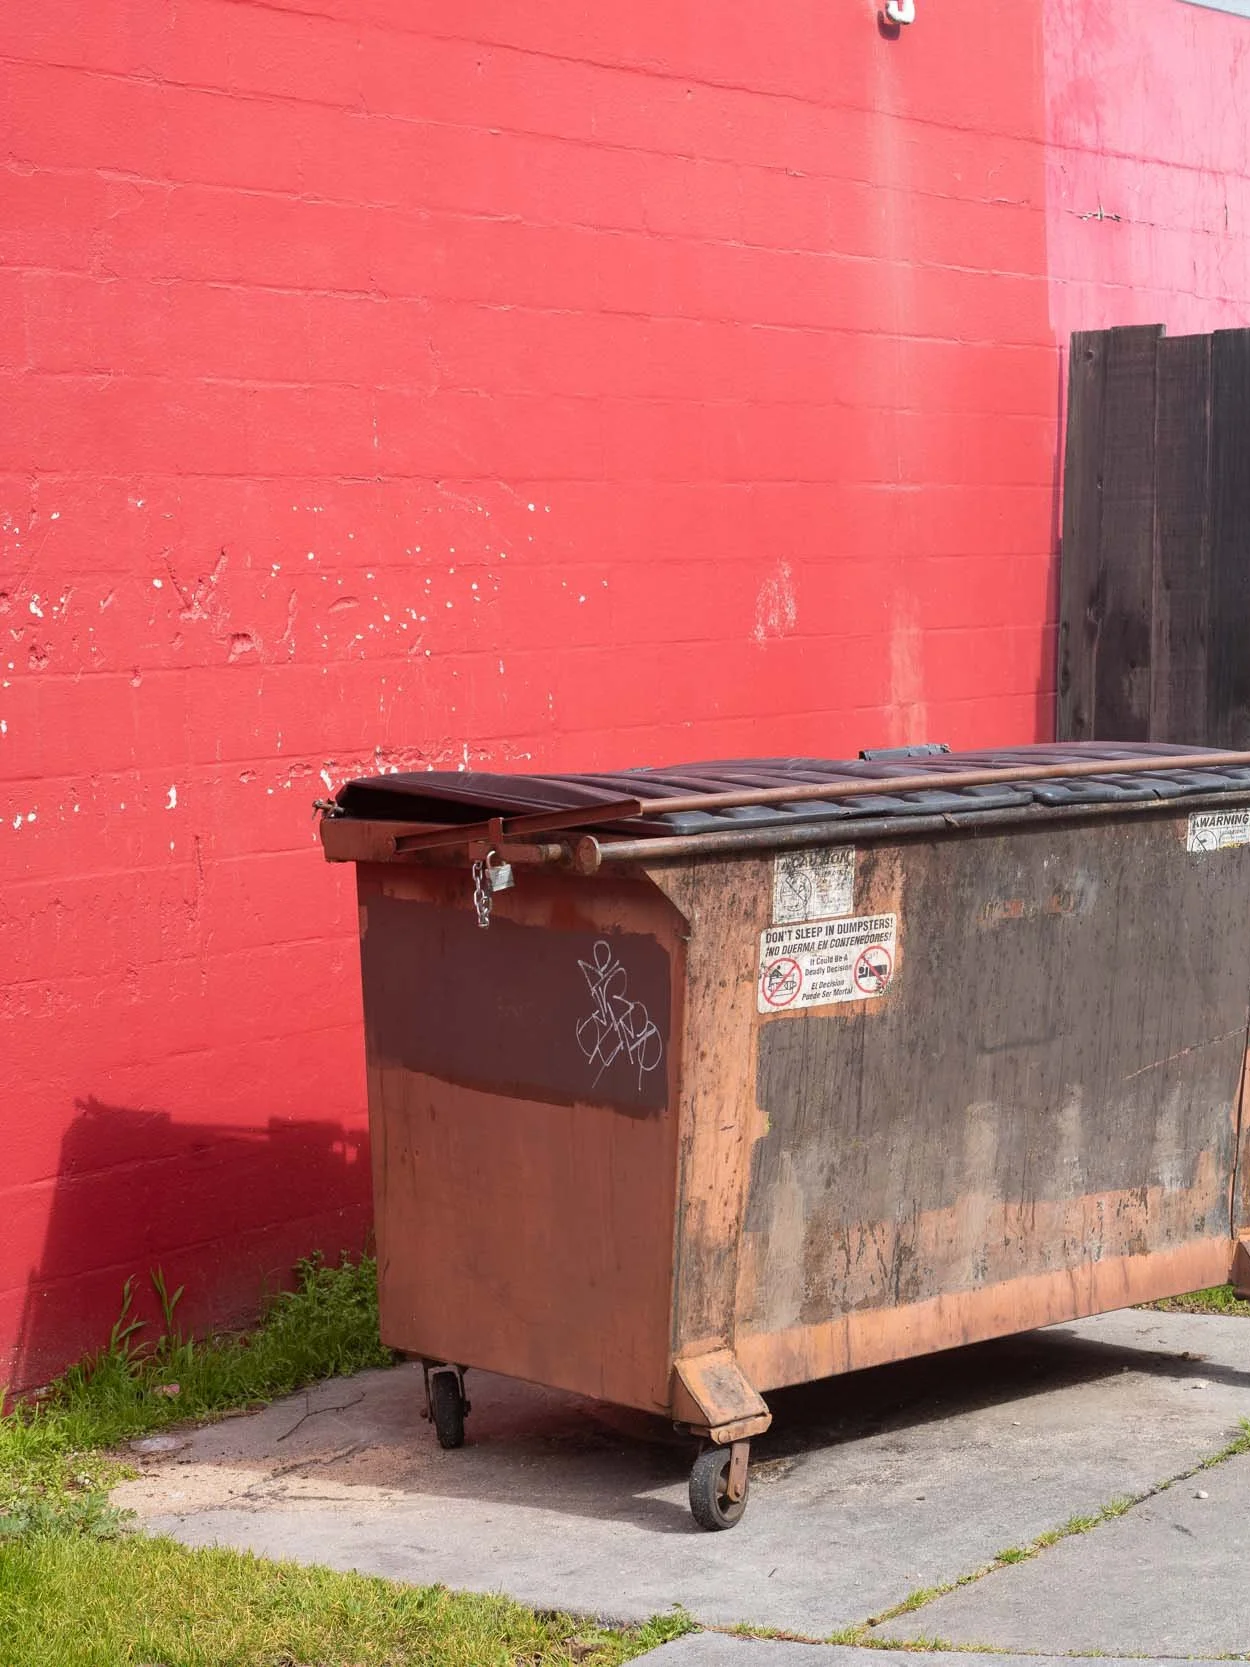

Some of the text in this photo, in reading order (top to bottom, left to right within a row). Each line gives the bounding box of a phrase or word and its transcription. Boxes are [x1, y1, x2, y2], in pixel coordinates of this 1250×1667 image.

[1200, 813, 1250, 828] WARNING
[765, 917, 894, 944] DON'T SLEEP IN DUMPSTERS!
[782, 942, 815, 955] DUERMA
[817, 939, 827, 950] EN
[829, 931, 893, 949] CONTENEDORES!
[810, 953, 849, 966] It Could Be A
[805, 963, 852, 977] Deadly Decision
[818, 979, 845, 988] Decision
[801, 986, 854, 1001] Puede Ser Mortal
